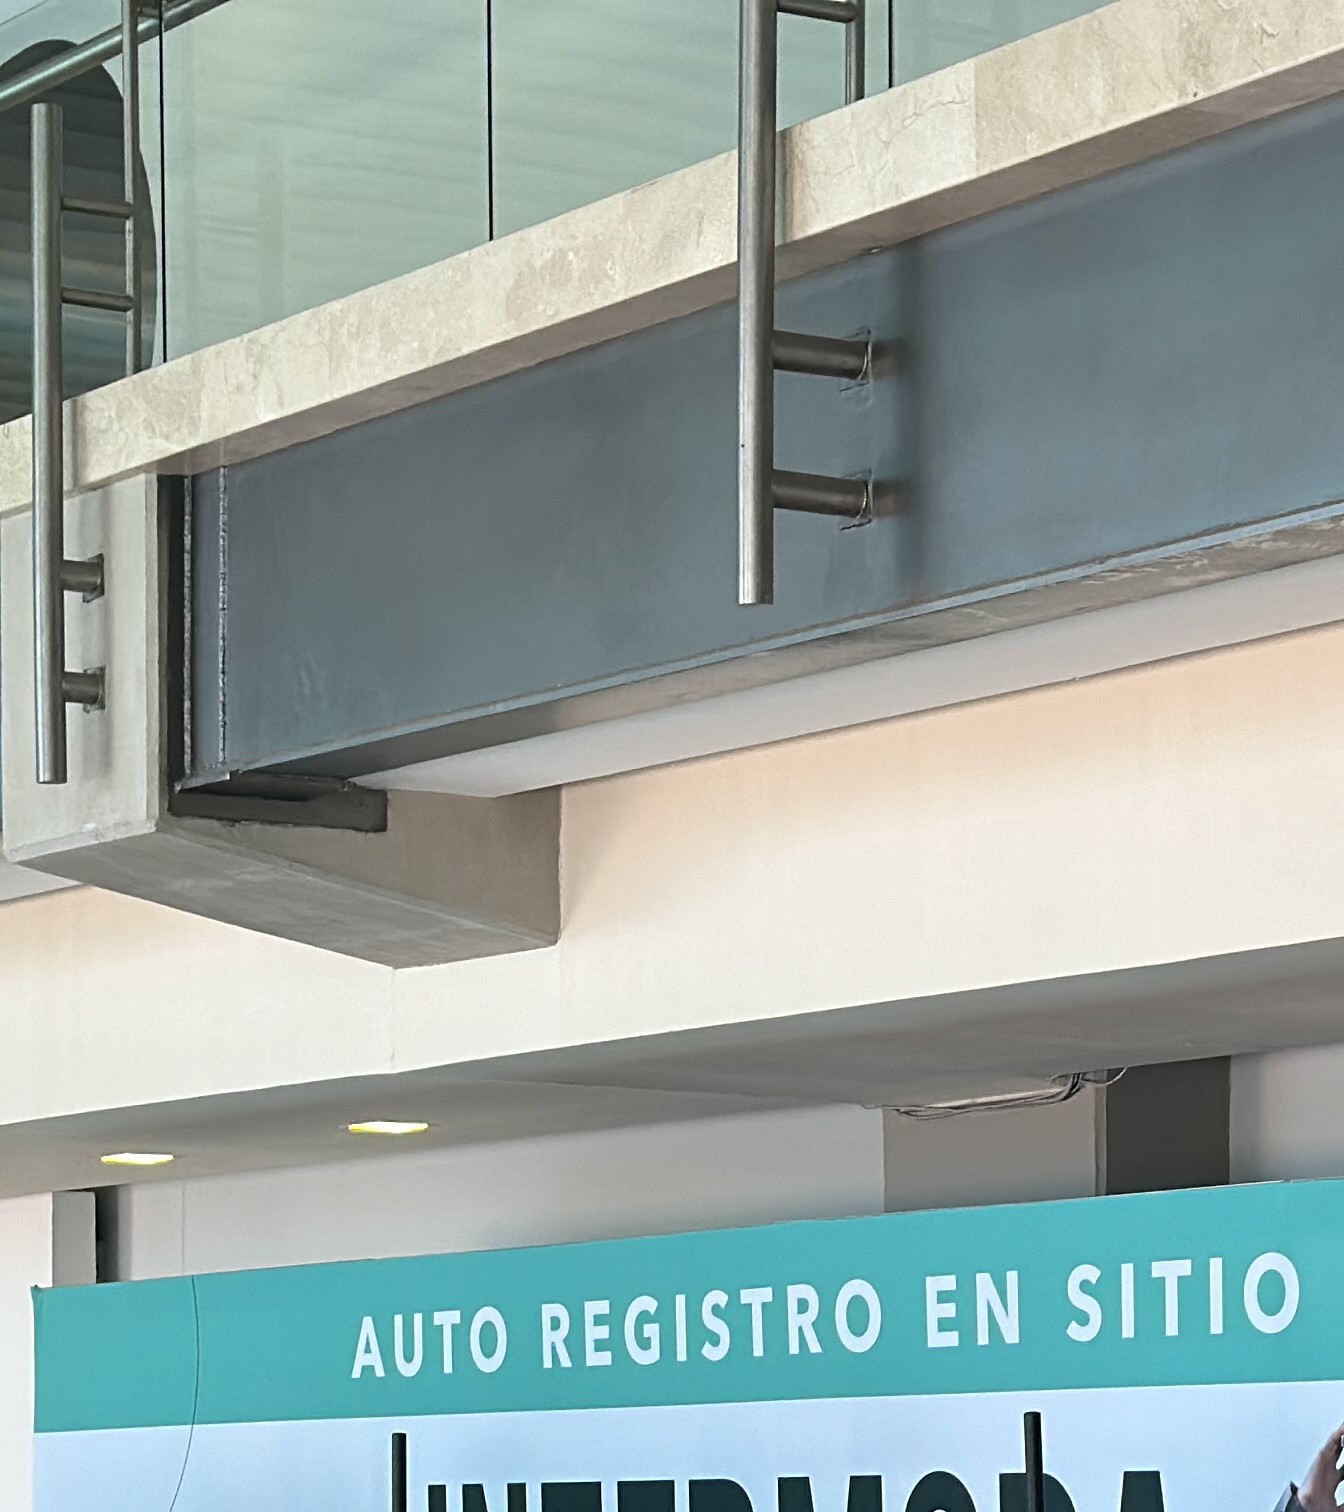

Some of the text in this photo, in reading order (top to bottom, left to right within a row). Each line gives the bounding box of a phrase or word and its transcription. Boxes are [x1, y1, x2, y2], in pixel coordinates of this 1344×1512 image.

[351, 1252, 1300, 1379] AUTO REGISTRO EN SITIO
